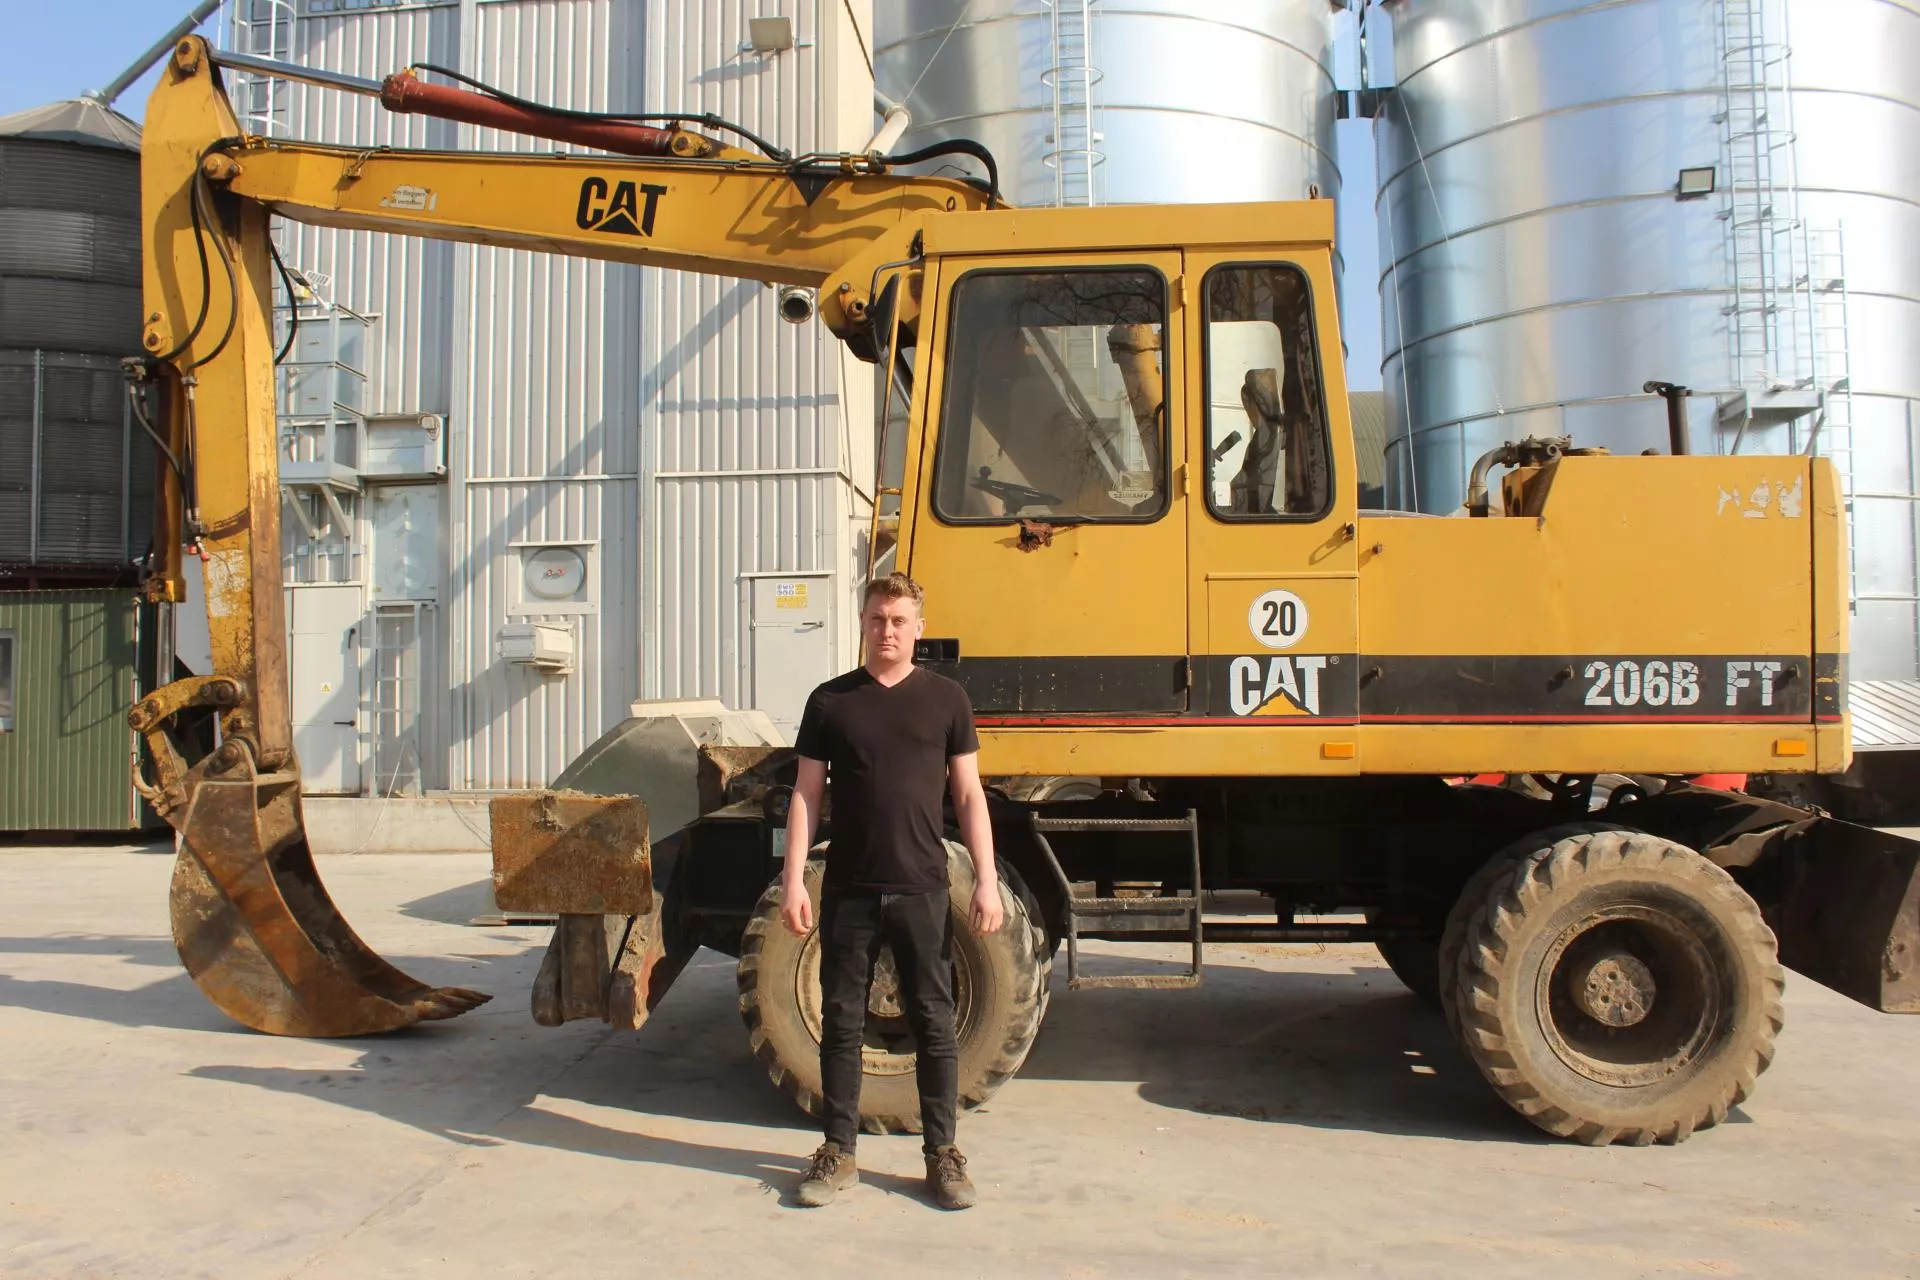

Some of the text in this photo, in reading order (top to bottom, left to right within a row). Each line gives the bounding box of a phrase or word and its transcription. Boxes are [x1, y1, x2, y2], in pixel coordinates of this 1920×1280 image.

[576, 176, 668, 238] CAT
[1261, 600, 1297, 636] 20
[1229, 655, 1327, 717] CAT
[1584, 660, 1782, 706] 206B FT
